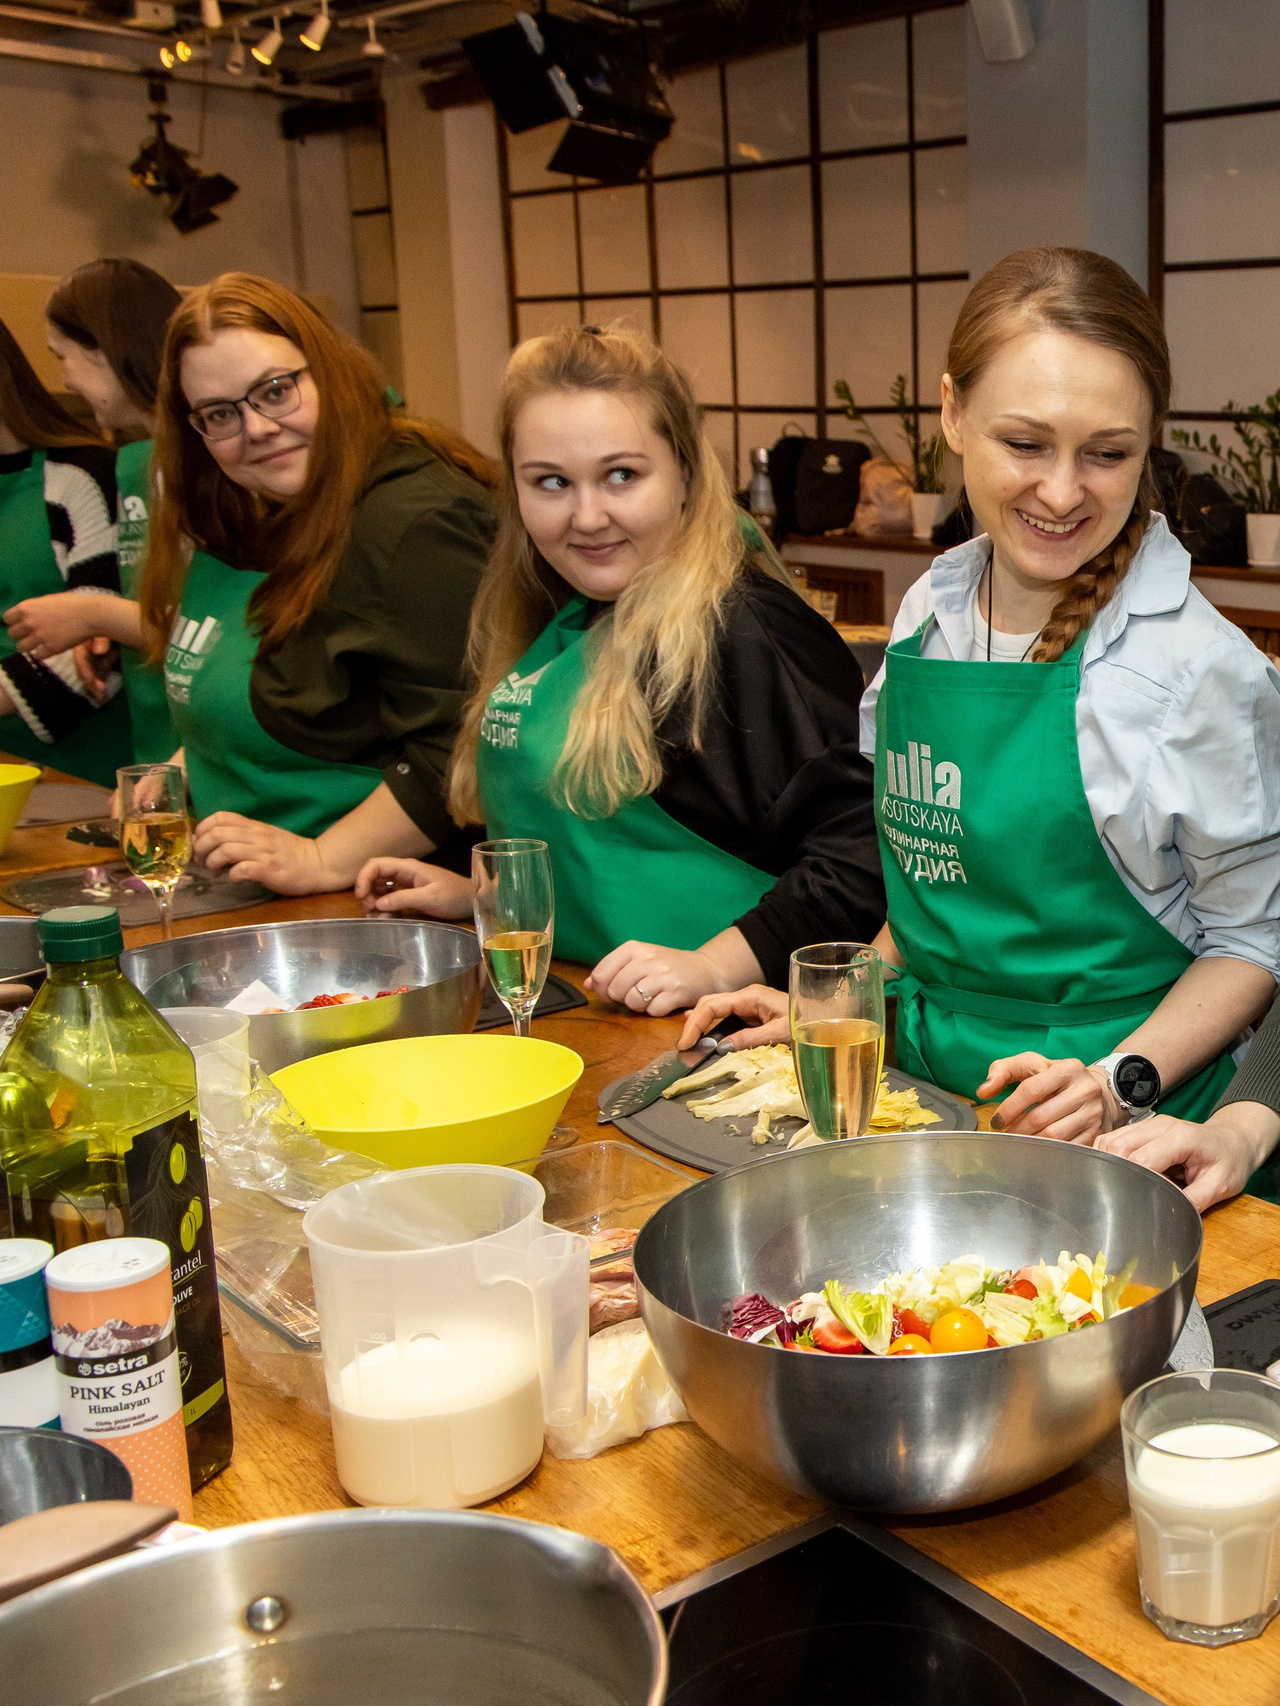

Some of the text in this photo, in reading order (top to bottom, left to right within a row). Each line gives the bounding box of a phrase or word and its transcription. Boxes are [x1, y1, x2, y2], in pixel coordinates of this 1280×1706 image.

[887, 741, 962, 810] ulia
[889, 840, 967, 884] ТУДИЯ
[93, 1354, 148, 1376] setra
[70, 1369, 165, 1400] PINK SALT
[88, 1396, 151, 1414] Himalayan
